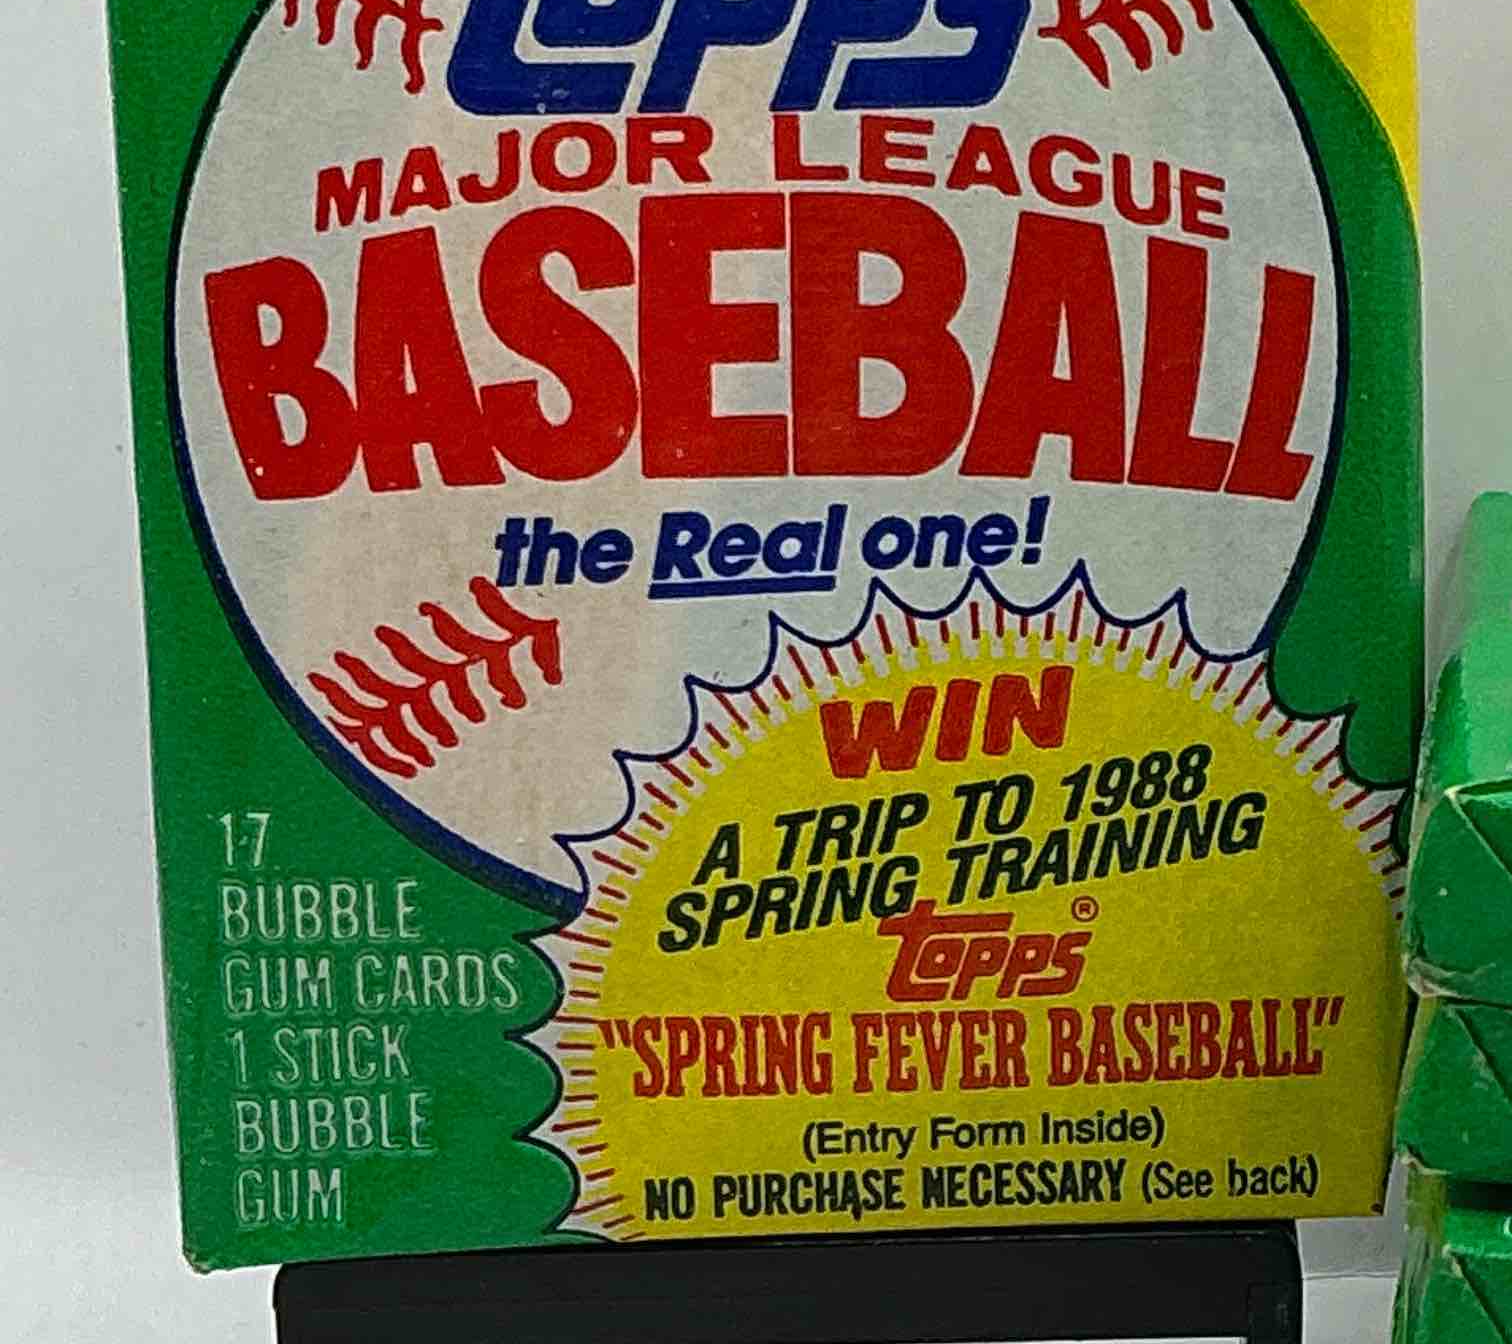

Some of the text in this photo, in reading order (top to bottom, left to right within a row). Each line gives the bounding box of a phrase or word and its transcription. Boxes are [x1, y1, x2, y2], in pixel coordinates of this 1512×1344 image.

[315, 115, 1230, 239] MAJOR LEAGUE
[204, 191, 1316, 503] BASEBALL
[495, 495, 1051, 597] the Real one!
[819, 665, 1074, 778] WIN
[218, 812, 271, 867] 17
[692, 743, 1214, 886] A TRIP TO 1988
[656, 792, 1267, 953] SPRING TRAINING
[222, 880, 423, 941] BUBBLE
[224, 953, 520, 1012] GUM CARDS
[231, 1024, 410, 1083] 1 STICK
[599, 996, 1344, 1098] "SPRING FEVER BASEBALL"
[235, 1092, 434, 1154] BUBBLE
[803, 1105, 1165, 1164] (Entry Form Inside)
[238, 1167, 343, 1224] GUM
[644, 1153, 1319, 1221] NO PURCHASE NECESSARY (See back)
